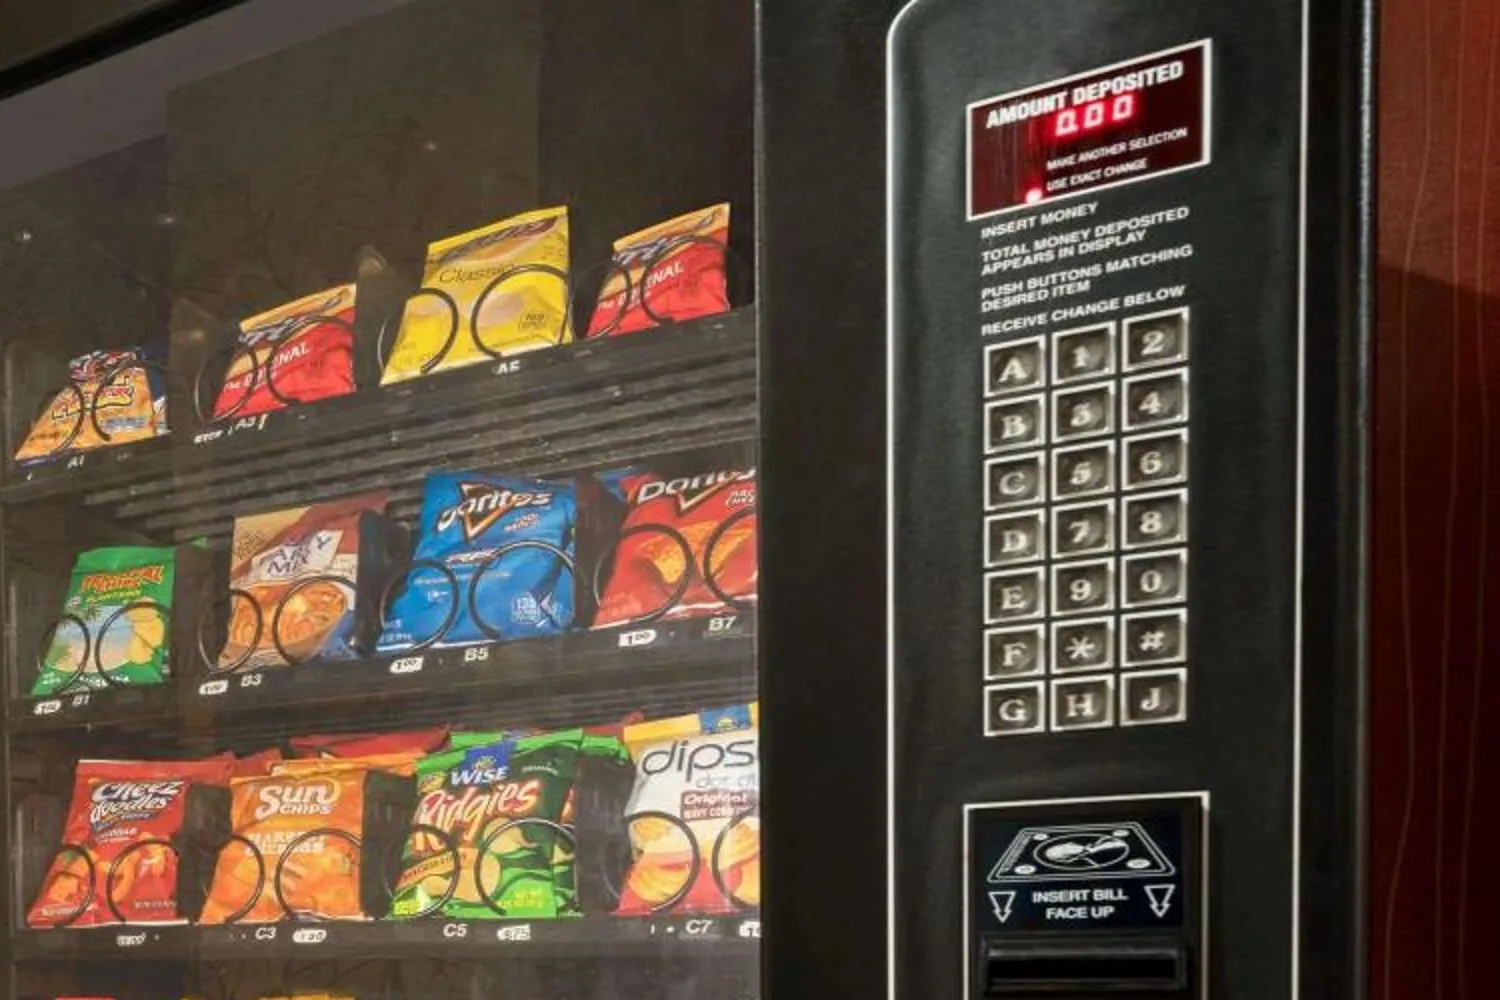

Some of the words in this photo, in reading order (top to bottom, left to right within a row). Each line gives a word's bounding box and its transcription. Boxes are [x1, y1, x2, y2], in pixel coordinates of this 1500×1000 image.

[986, 92, 1067, 129] AMOUNT
[1072, 60, 1184, 107] DEPOSITED
[1047, 156, 1076, 170] MAKE
[1078, 140, 1128, 163] ANOTHER
[1130, 128, 1187, 150] SELECTION
[1047, 177, 1068, 190] USE
[1070, 169, 1102, 186] EXACT
[1104, 158, 1147, 177] CHANGE
[981, 217, 1036, 239] INSERT
[1041, 201, 1099, 225] MONEY
[981, 240, 1030, 263] TOTAL
[1033, 225, 1090, 250] MONEY
[1095, 206, 1190, 237] DEPOSITED
[981, 251, 1054, 276] APPEARS
[1058, 244, 1075, 258] IN
[1078, 230, 1147, 255] DISPLAY
[981, 281, 1023, 299] PUSH
[1028, 264, 1101, 289] BUTTONS
[1106, 244, 1193, 273] MATCHING
[981, 289, 1049, 312] DESIRED
[1052, 280, 1091, 297] ITEM
[981, 314, 1047, 336] RECEIVE
[1051, 297, 1119, 321] CHANGE
[1124, 285, 1186, 308] BELOW
[1140, 330, 1164, 356] 2
[998, 356, 1027, 382] A
[1072, 346, 1090, 369] 1
[1071, 402, 1092, 427] 3
[1139, 392, 1162, 414] 4
[1002, 415, 1027, 439] B
[1069, 462, 1092, 485] 5
[1140, 451, 1163, 474] 6
[999, 472, 1025, 495] C
[437, 490, 552, 533] Doritos
[1140, 511, 1163, 534] 8
[1001, 529, 1027, 553] D
[1069, 520, 1090, 543] 7
[1001, 586, 1027, 610] E
[1069, 579, 1092, 600] 9
[708, 616, 737, 631] B7
[464, 646, 489, 662] B5
[1002, 642, 1027, 667] F
[999, 699, 1027, 721] G
[1066, 693, 1095, 717] H
[1140, 687, 1161, 711] J
[450, 766, 509, 786] WISE
[255, 784, 335, 820] Sun
[279, 802, 333, 816] CHIPS
[415, 779, 542, 842] Ridgies
[1032, 889, 1090, 903] INSERT
[1093, 888, 1129, 901] BILL
[1046, 907, 1088, 920] FACE
[1091, 906, 1115, 918] UP
[255, 927, 276, 941] C3
[442, 922, 468, 938] C5
[686, 919, 712, 935] C7
